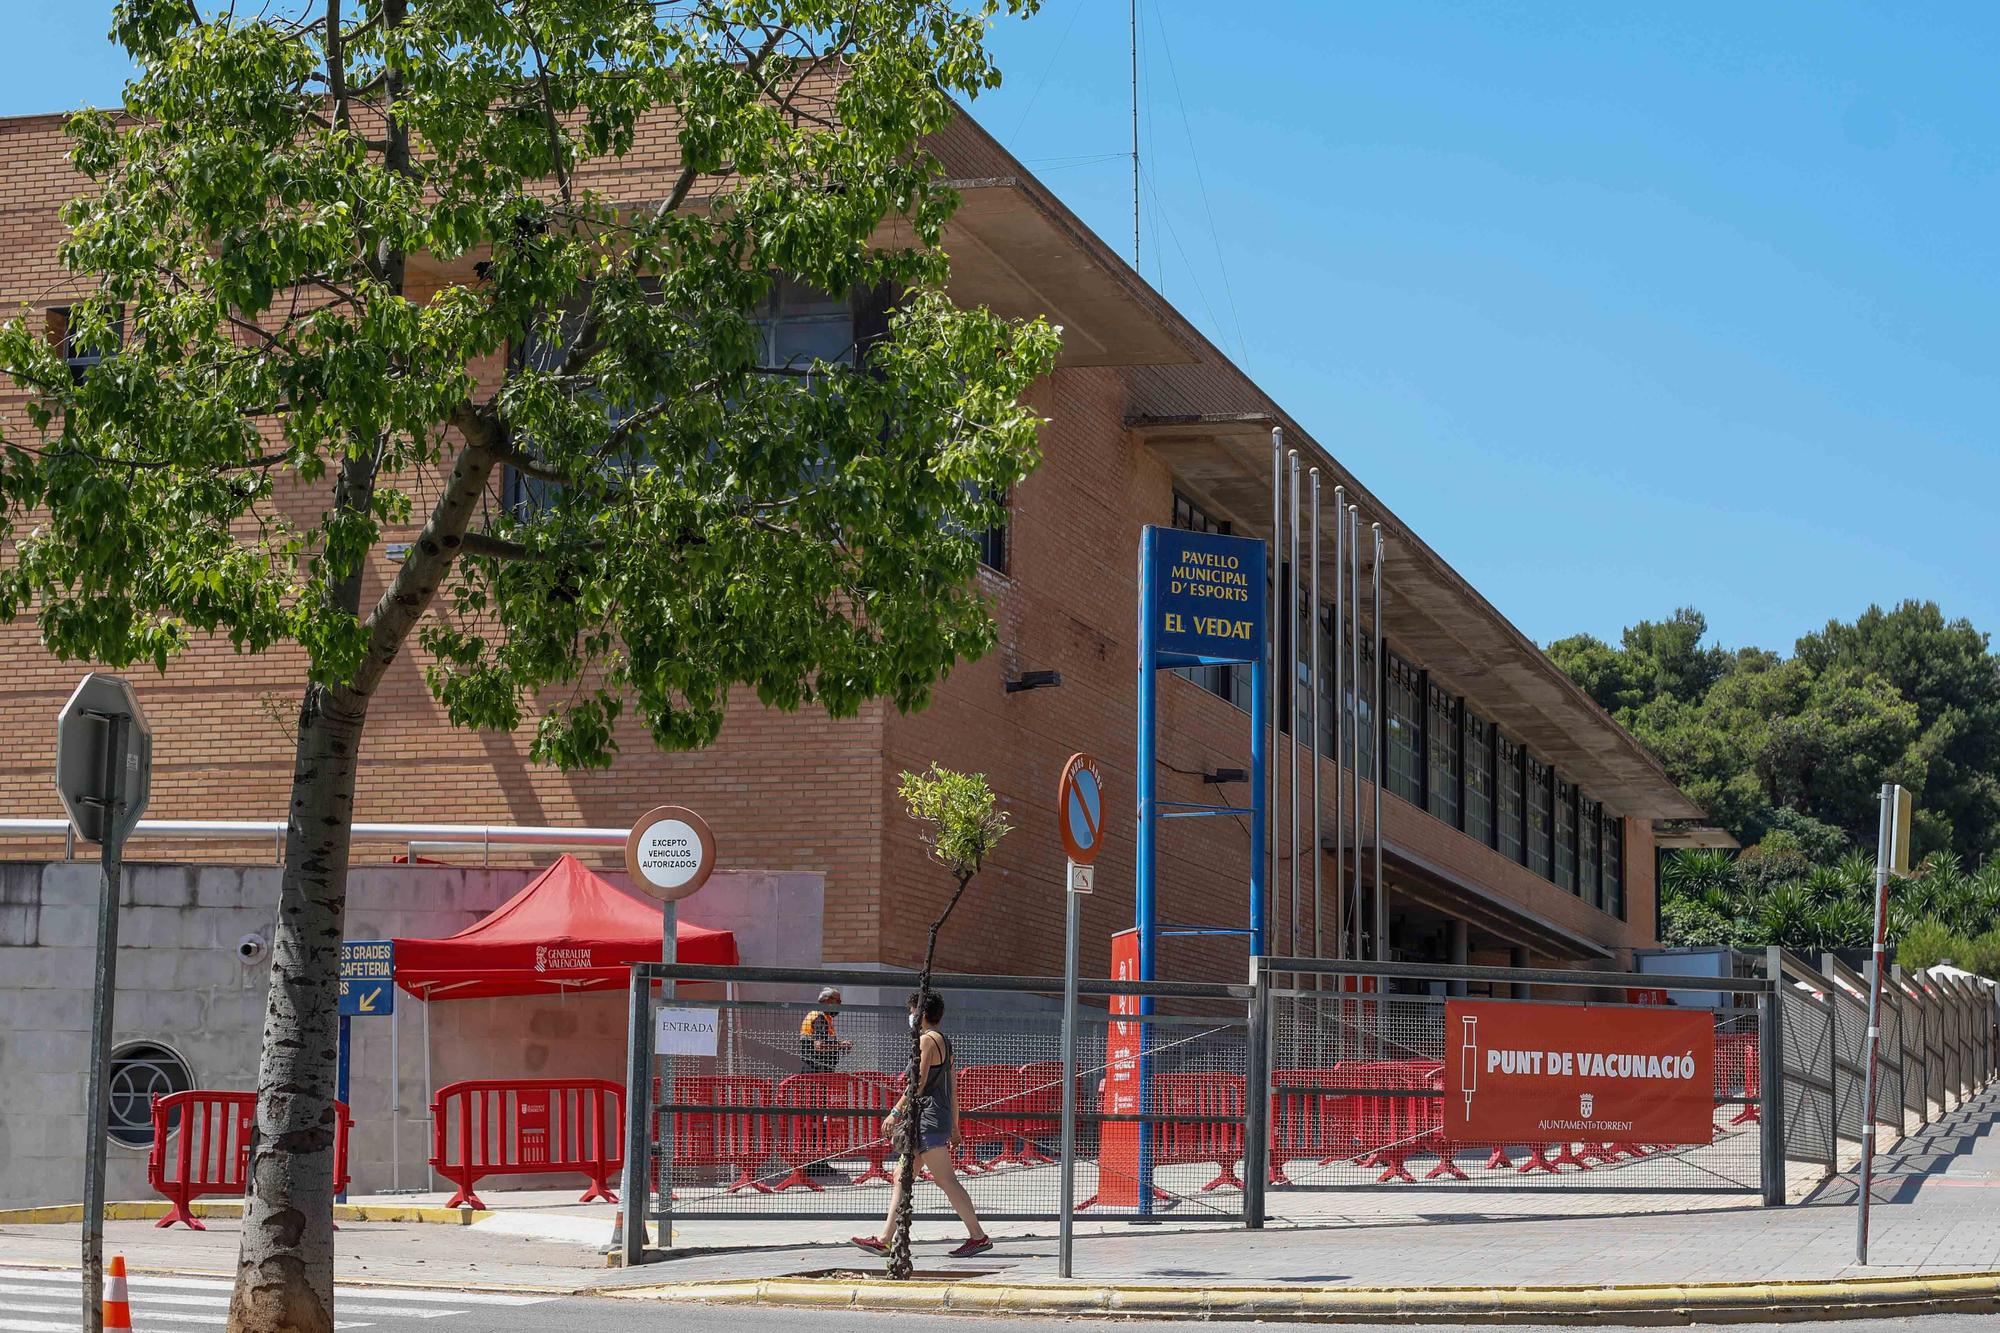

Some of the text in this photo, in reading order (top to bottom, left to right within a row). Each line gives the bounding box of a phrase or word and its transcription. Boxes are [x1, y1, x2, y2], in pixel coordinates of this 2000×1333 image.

[1182, 550, 1239, 570] PAVELLO
[1171, 565, 1248, 586] MUNICIPAL
[1165, 612, 1254, 640] EL VEDAT
[652, 839, 687, 847] EXCEPTO
[648, 849, 691, 858] VEHICULOS
[642, 860, 697, 868] AUTORIZADOS
[353, 945, 391, 960] GRADES
[547, 948, 592, 959] GENERALITAT
[340, 961, 390, 976] CAFETERIA
[547, 958, 592, 968] VALENCIANA
[662, 1021, 714, 1033] ENTRADA
[1487, 1050, 1695, 1080] PUNT DE VACUNACIÓ
[1538, 1119, 1592, 1131] AJUNTAMENT
[1596, 1120, 1633, 1131] TORRENT
